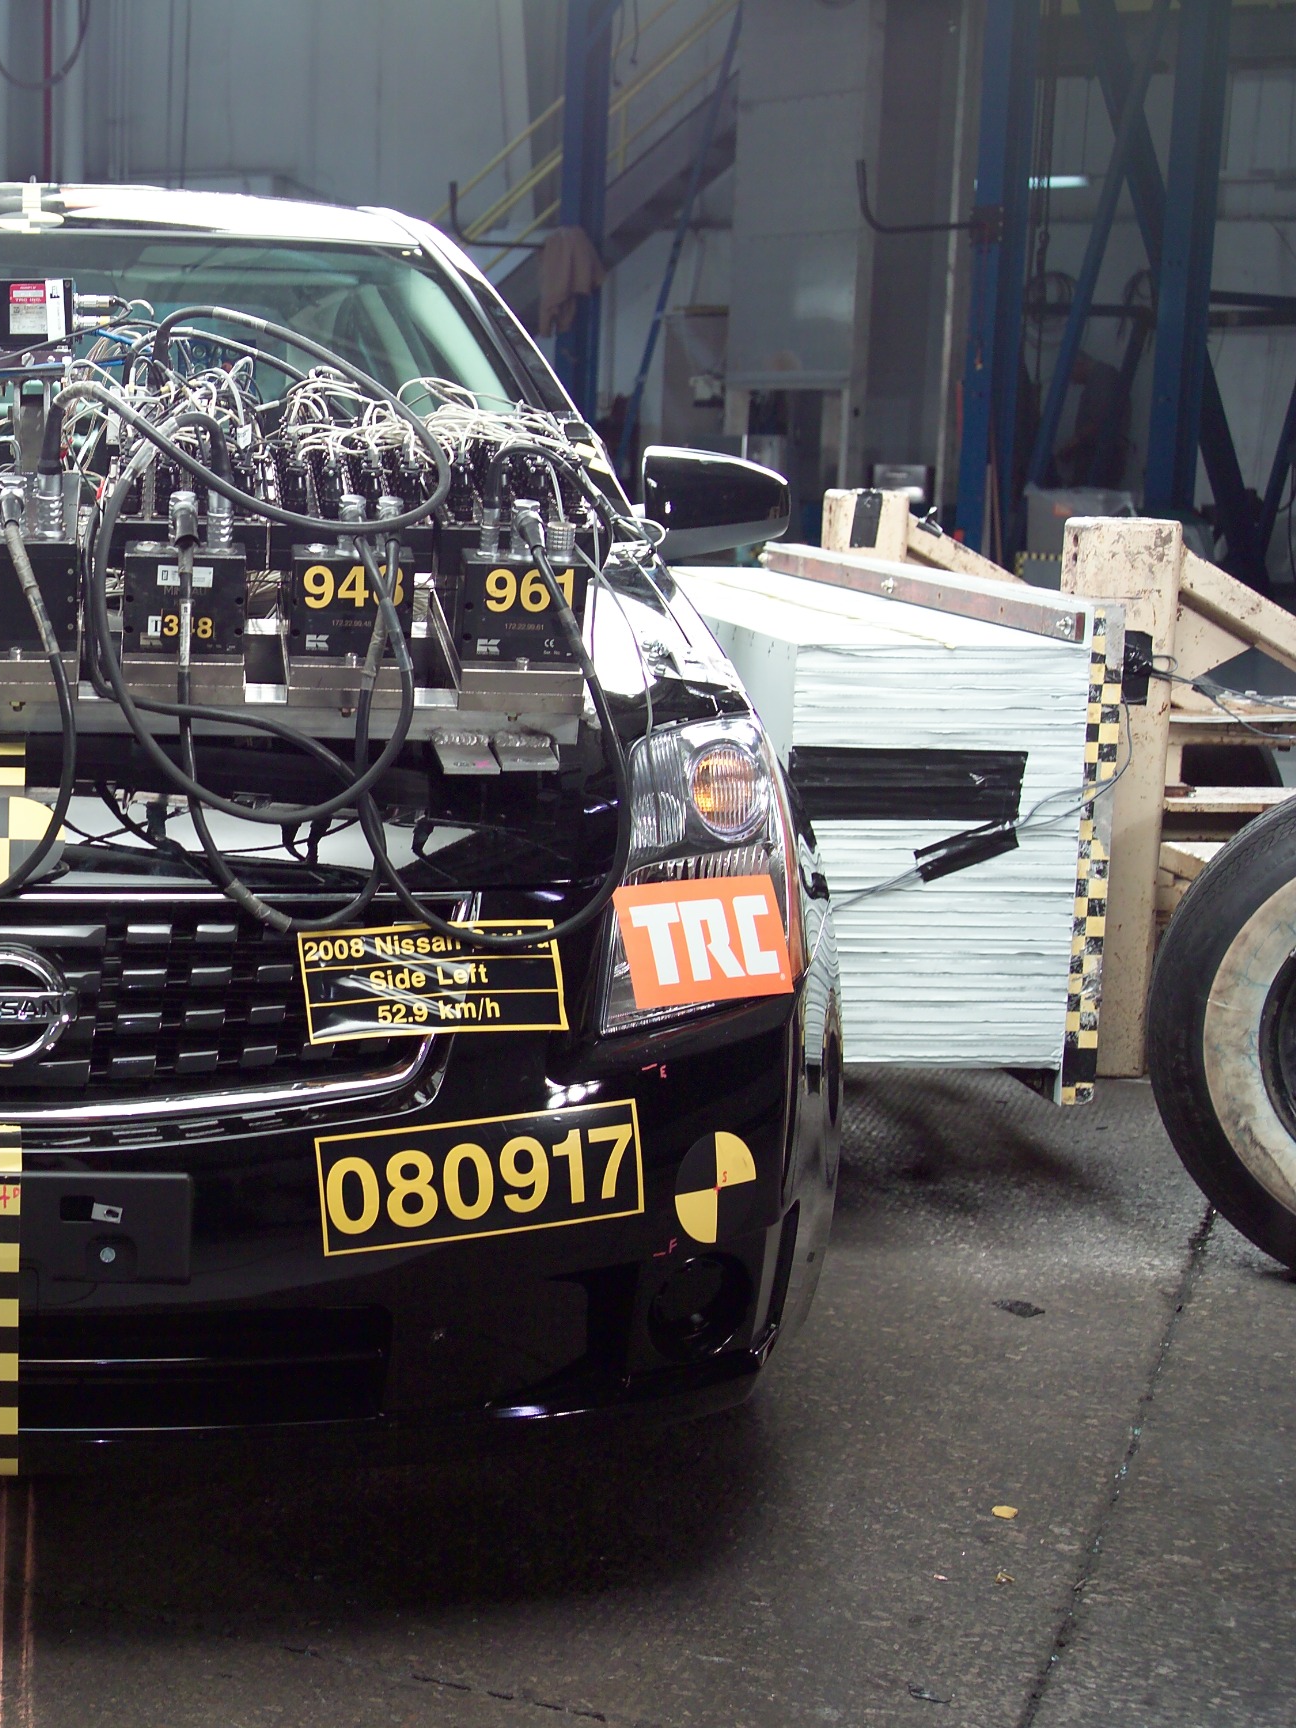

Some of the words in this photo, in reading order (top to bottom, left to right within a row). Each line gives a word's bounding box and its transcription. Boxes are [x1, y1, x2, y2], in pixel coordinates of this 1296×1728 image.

[304, 565, 403, 608] 94
[486, 568, 574, 612] 961
[163, 615, 213, 639] 38
[304, 938, 365, 962] 2008
[374, 934, 461, 957] Nissan
[628, 894, 781, 986] TRC
[369, 970, 427, 991] Side
[437, 963, 489, 986] Left
[377, 1002, 429, 1025] 52.9
[439, 998, 501, 1021] km/h
[326, 1123, 633, 1235] 080917
